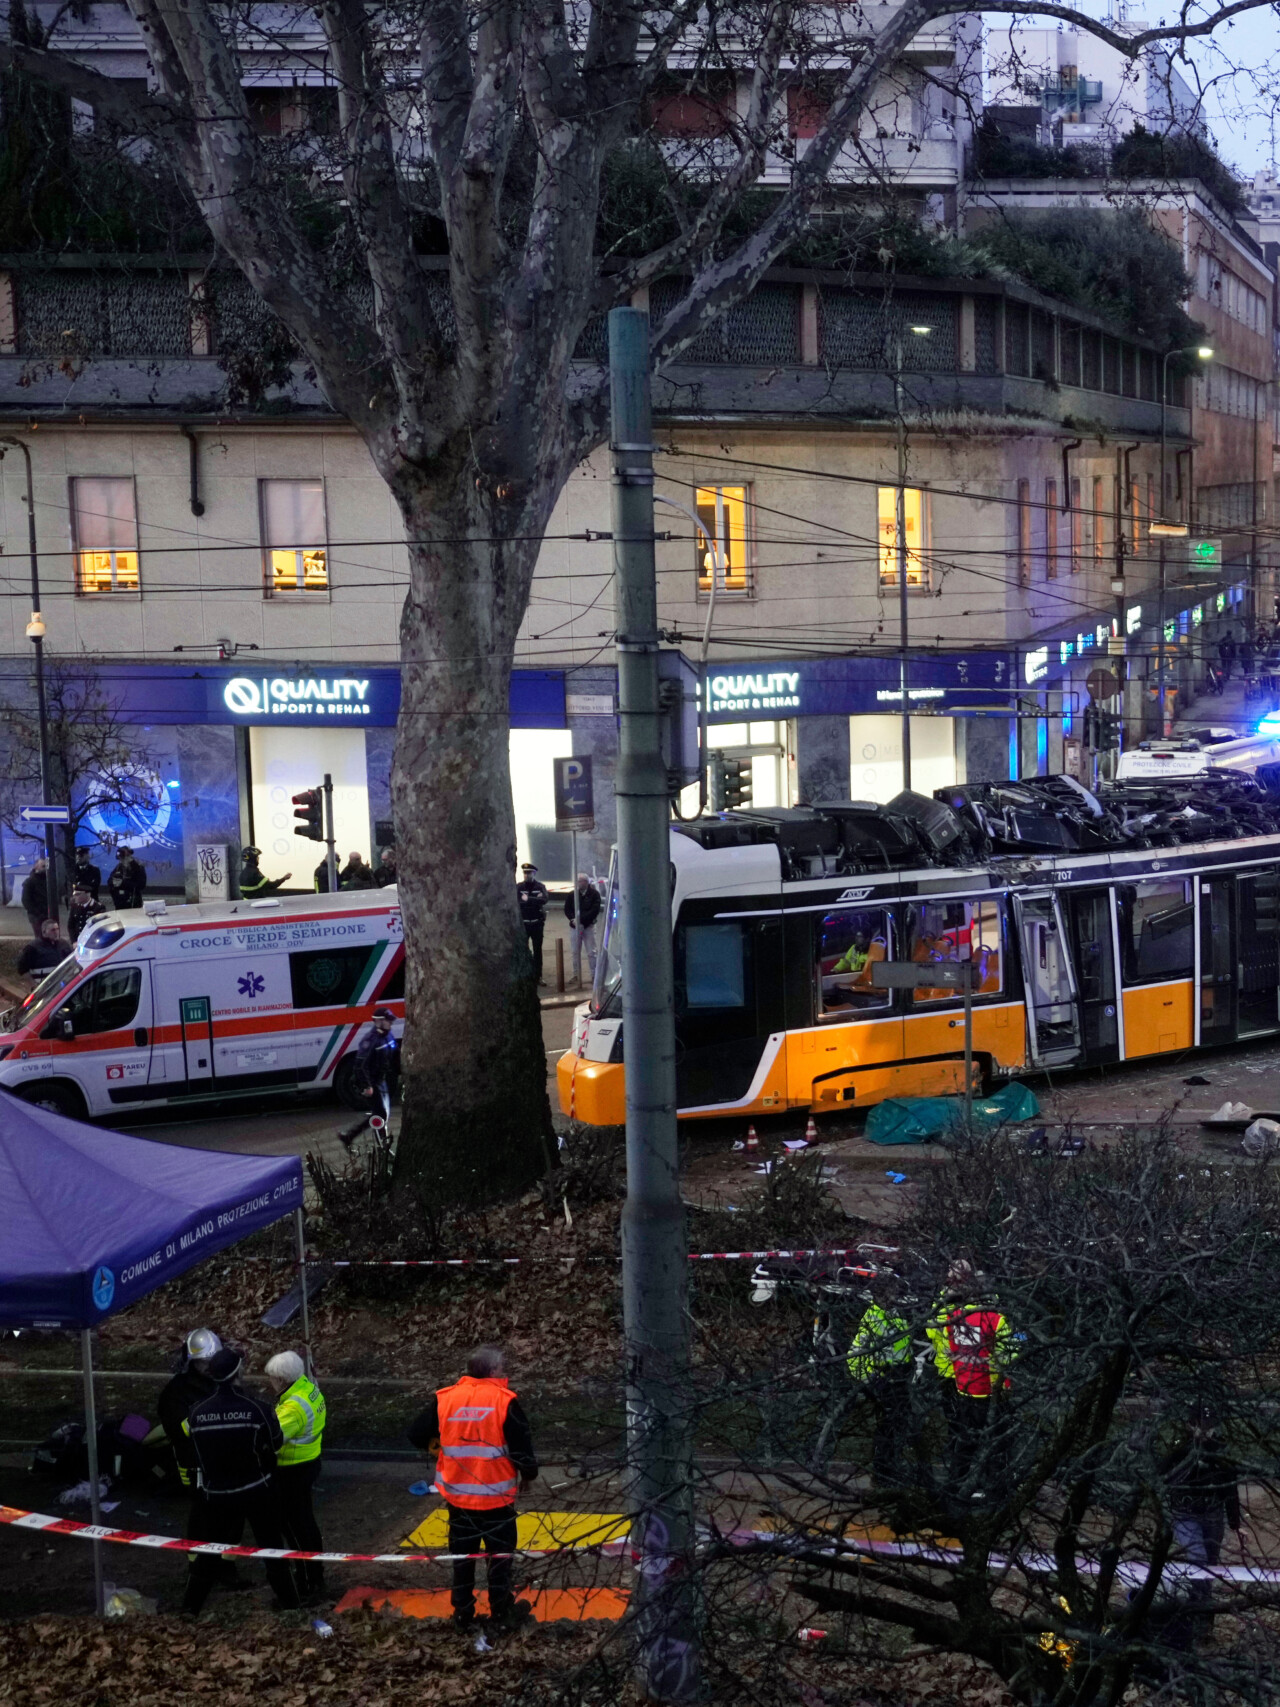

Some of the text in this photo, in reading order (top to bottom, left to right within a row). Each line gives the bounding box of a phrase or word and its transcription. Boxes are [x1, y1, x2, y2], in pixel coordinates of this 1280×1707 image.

[270, 679, 369, 701] QUALITY
[712, 672, 800, 699] QUALITY
[272, 703, 370, 714] SPORT & REHAB
[713, 696, 800, 711] SPORT & REHAB
[562, 760, 583, 789] P
[226, 921, 320, 935] PUBBLICA ASSISTENZA
[179, 923, 366, 950] CROCE VERDE SEMPIONE
[246, 941, 279, 951] MILANO
[211, 1002, 293, 1017] CENTRO MOBILE DI RIANIMAZIONE
[126, 1063, 146, 1071] AREU
[121, 1176, 298, 1284] COMUNE DI MILANO PROTEZIONE CIVILE
[196, 1411, 252, 1423] POLIZIA LOCALE
